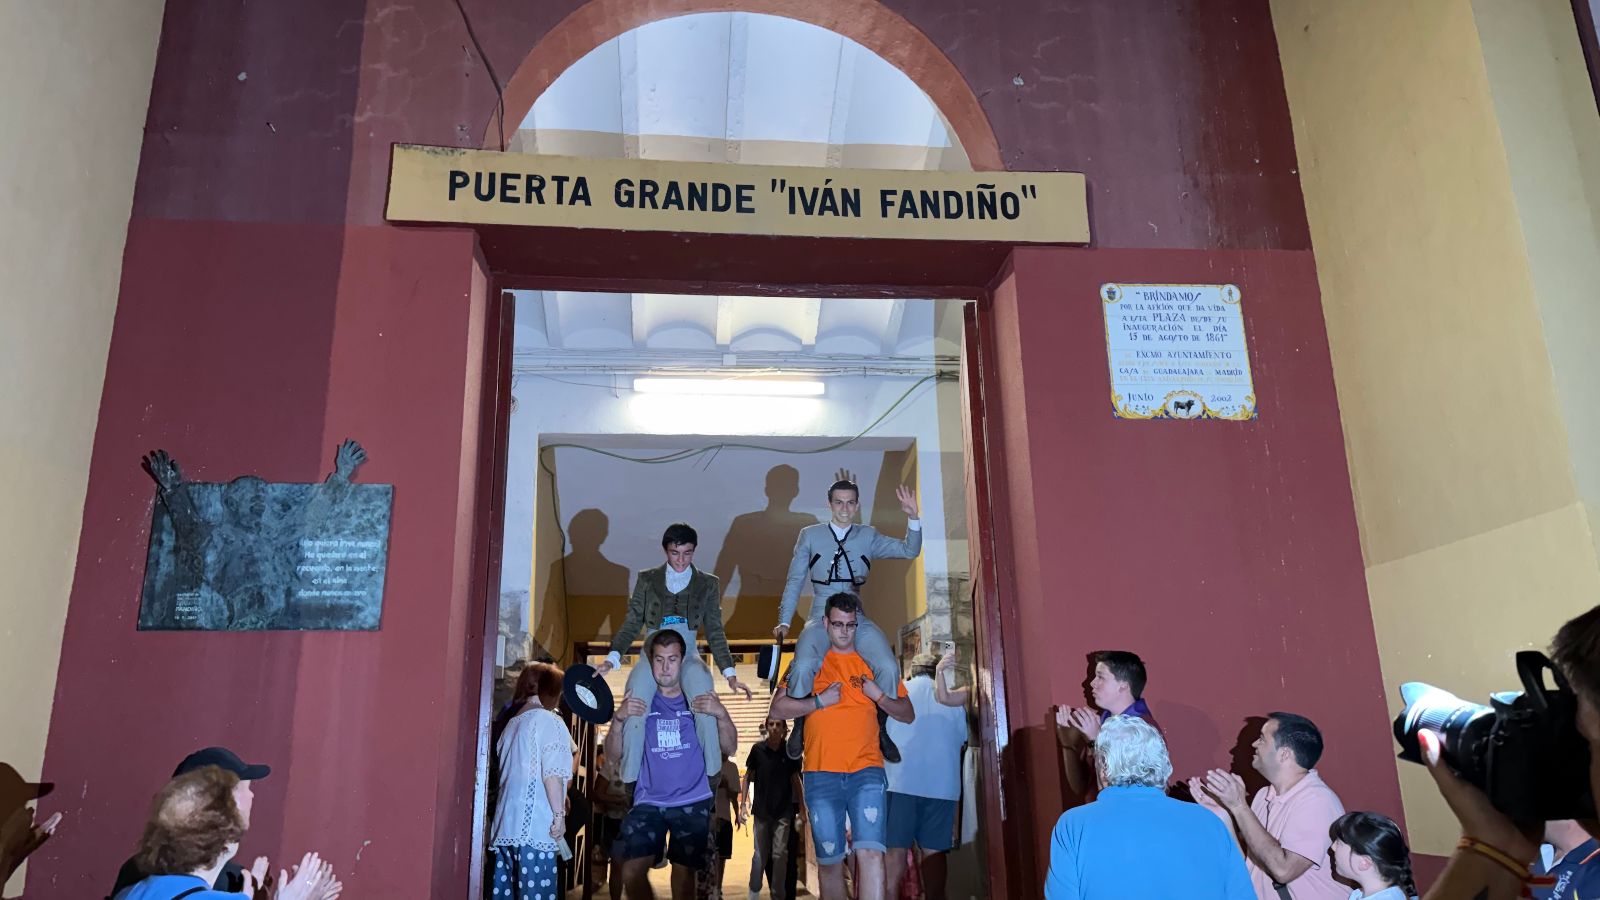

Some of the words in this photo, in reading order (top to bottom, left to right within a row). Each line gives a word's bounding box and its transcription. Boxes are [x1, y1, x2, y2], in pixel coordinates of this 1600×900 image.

[449, 170, 592, 206] PUERTA
[614, 178, 755, 213] GRANDE
[771, 178, 861, 217] "IVÁN
[880, 183, 1037, 220] FANDIÑO"
[1178, 304, 1190, 312] QUE
[1153, 313, 1187, 322] PLAZA
[1129, 332, 1138, 341] 15
[1158, 334, 1188, 343] AGOSTO
[1119, 368, 1139, 376] CASA
[1153, 368, 1204, 376] GUADALAJARA
[1214, 367, 1243, 376] MADRID
[1128, 392, 1154, 402] JUNIO
[1211, 394, 1232, 402] 2002
